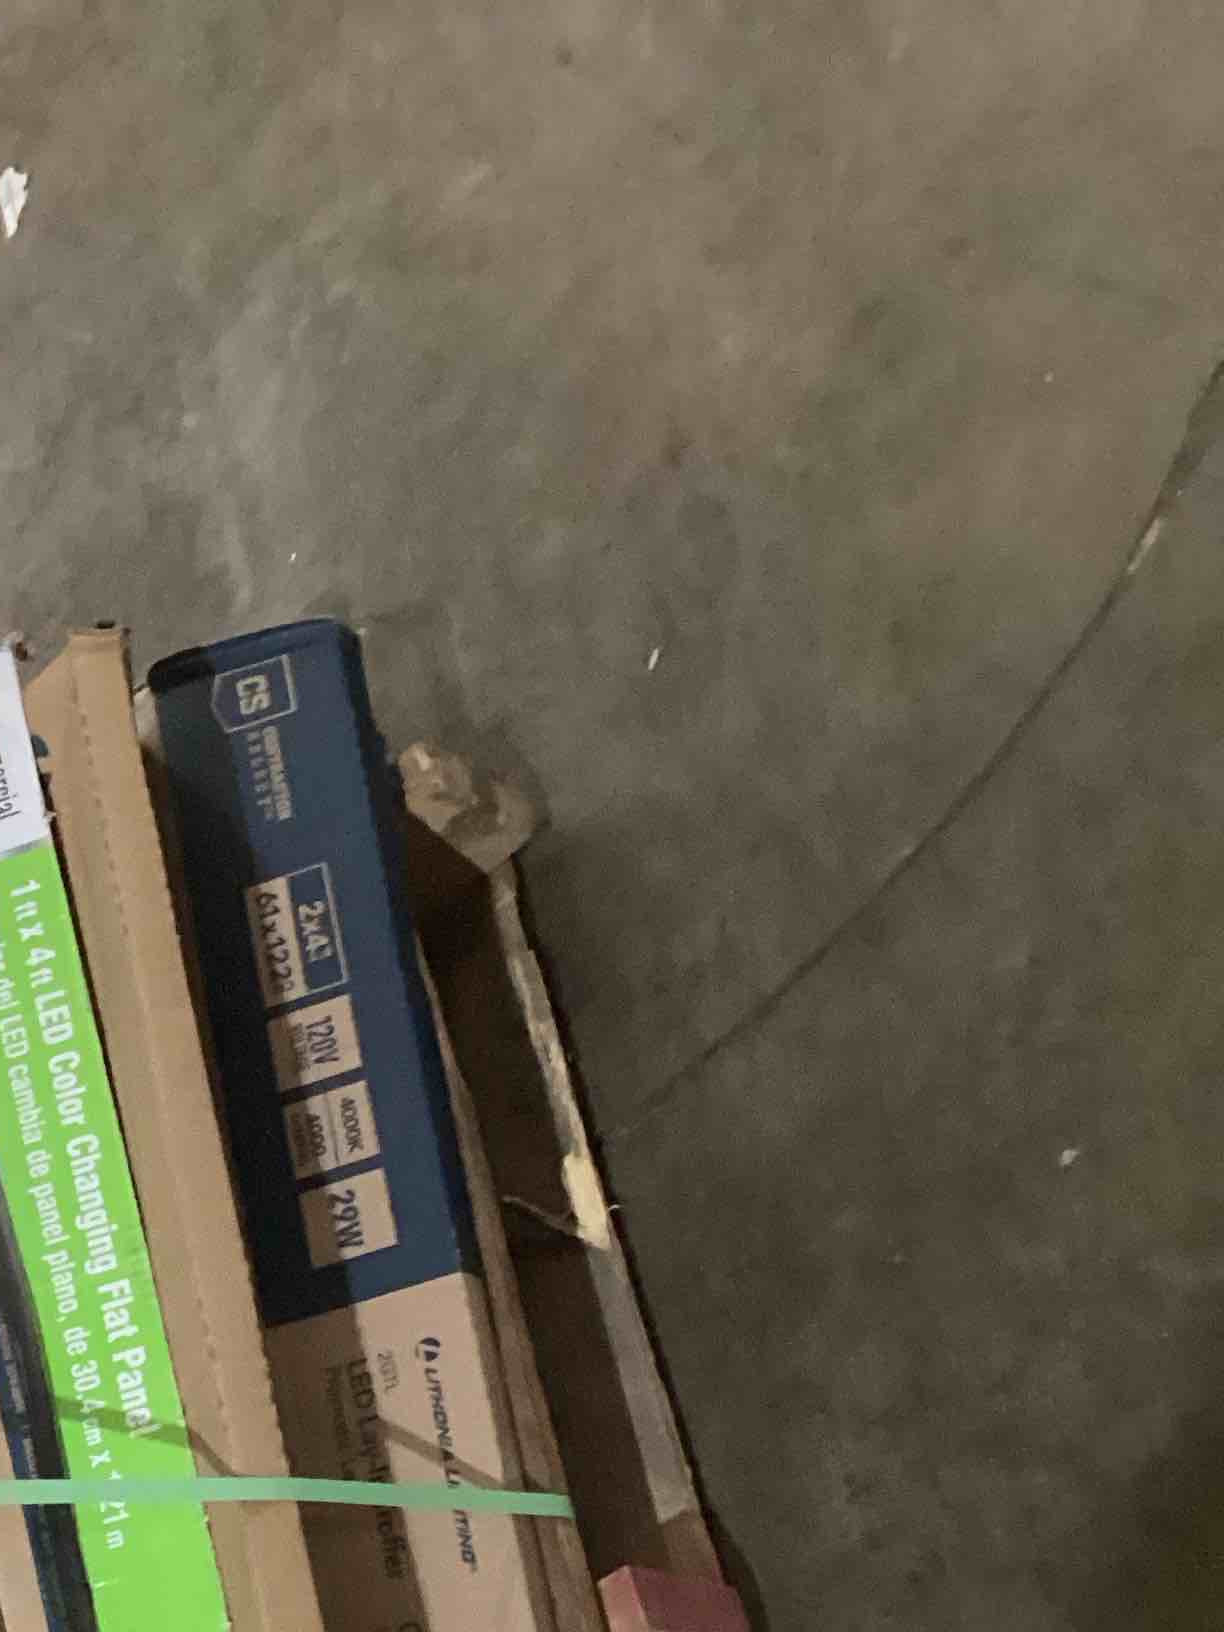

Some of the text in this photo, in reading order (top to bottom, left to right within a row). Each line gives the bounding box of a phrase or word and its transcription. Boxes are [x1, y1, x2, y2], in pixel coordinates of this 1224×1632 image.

[233, 673, 273, 716] CS
[18, 922, 44, 942] x
[33, 990, 74, 1045] LED
[304, 1015, 341, 1065] 120V
[7, 1063, 44, 1145] cambia
[48, 1050, 89, 1128] Color
[338, 1096, 365, 1153] 4000K
[25, 1149, 54, 1179] de
[28, 1182, 66, 1248] panel
[64, 1132, 120, 1275] Changing
[327, 1189, 365, 1250] 29W
[41, 1249, 79, 1323] plano,
[98, 1279, 140, 1341] Flat
[64, 1326, 92, 1357] de
[112, 1346, 163, 1440] Panel
[425, 1367, 478, 1566] LITHONIA LITING
